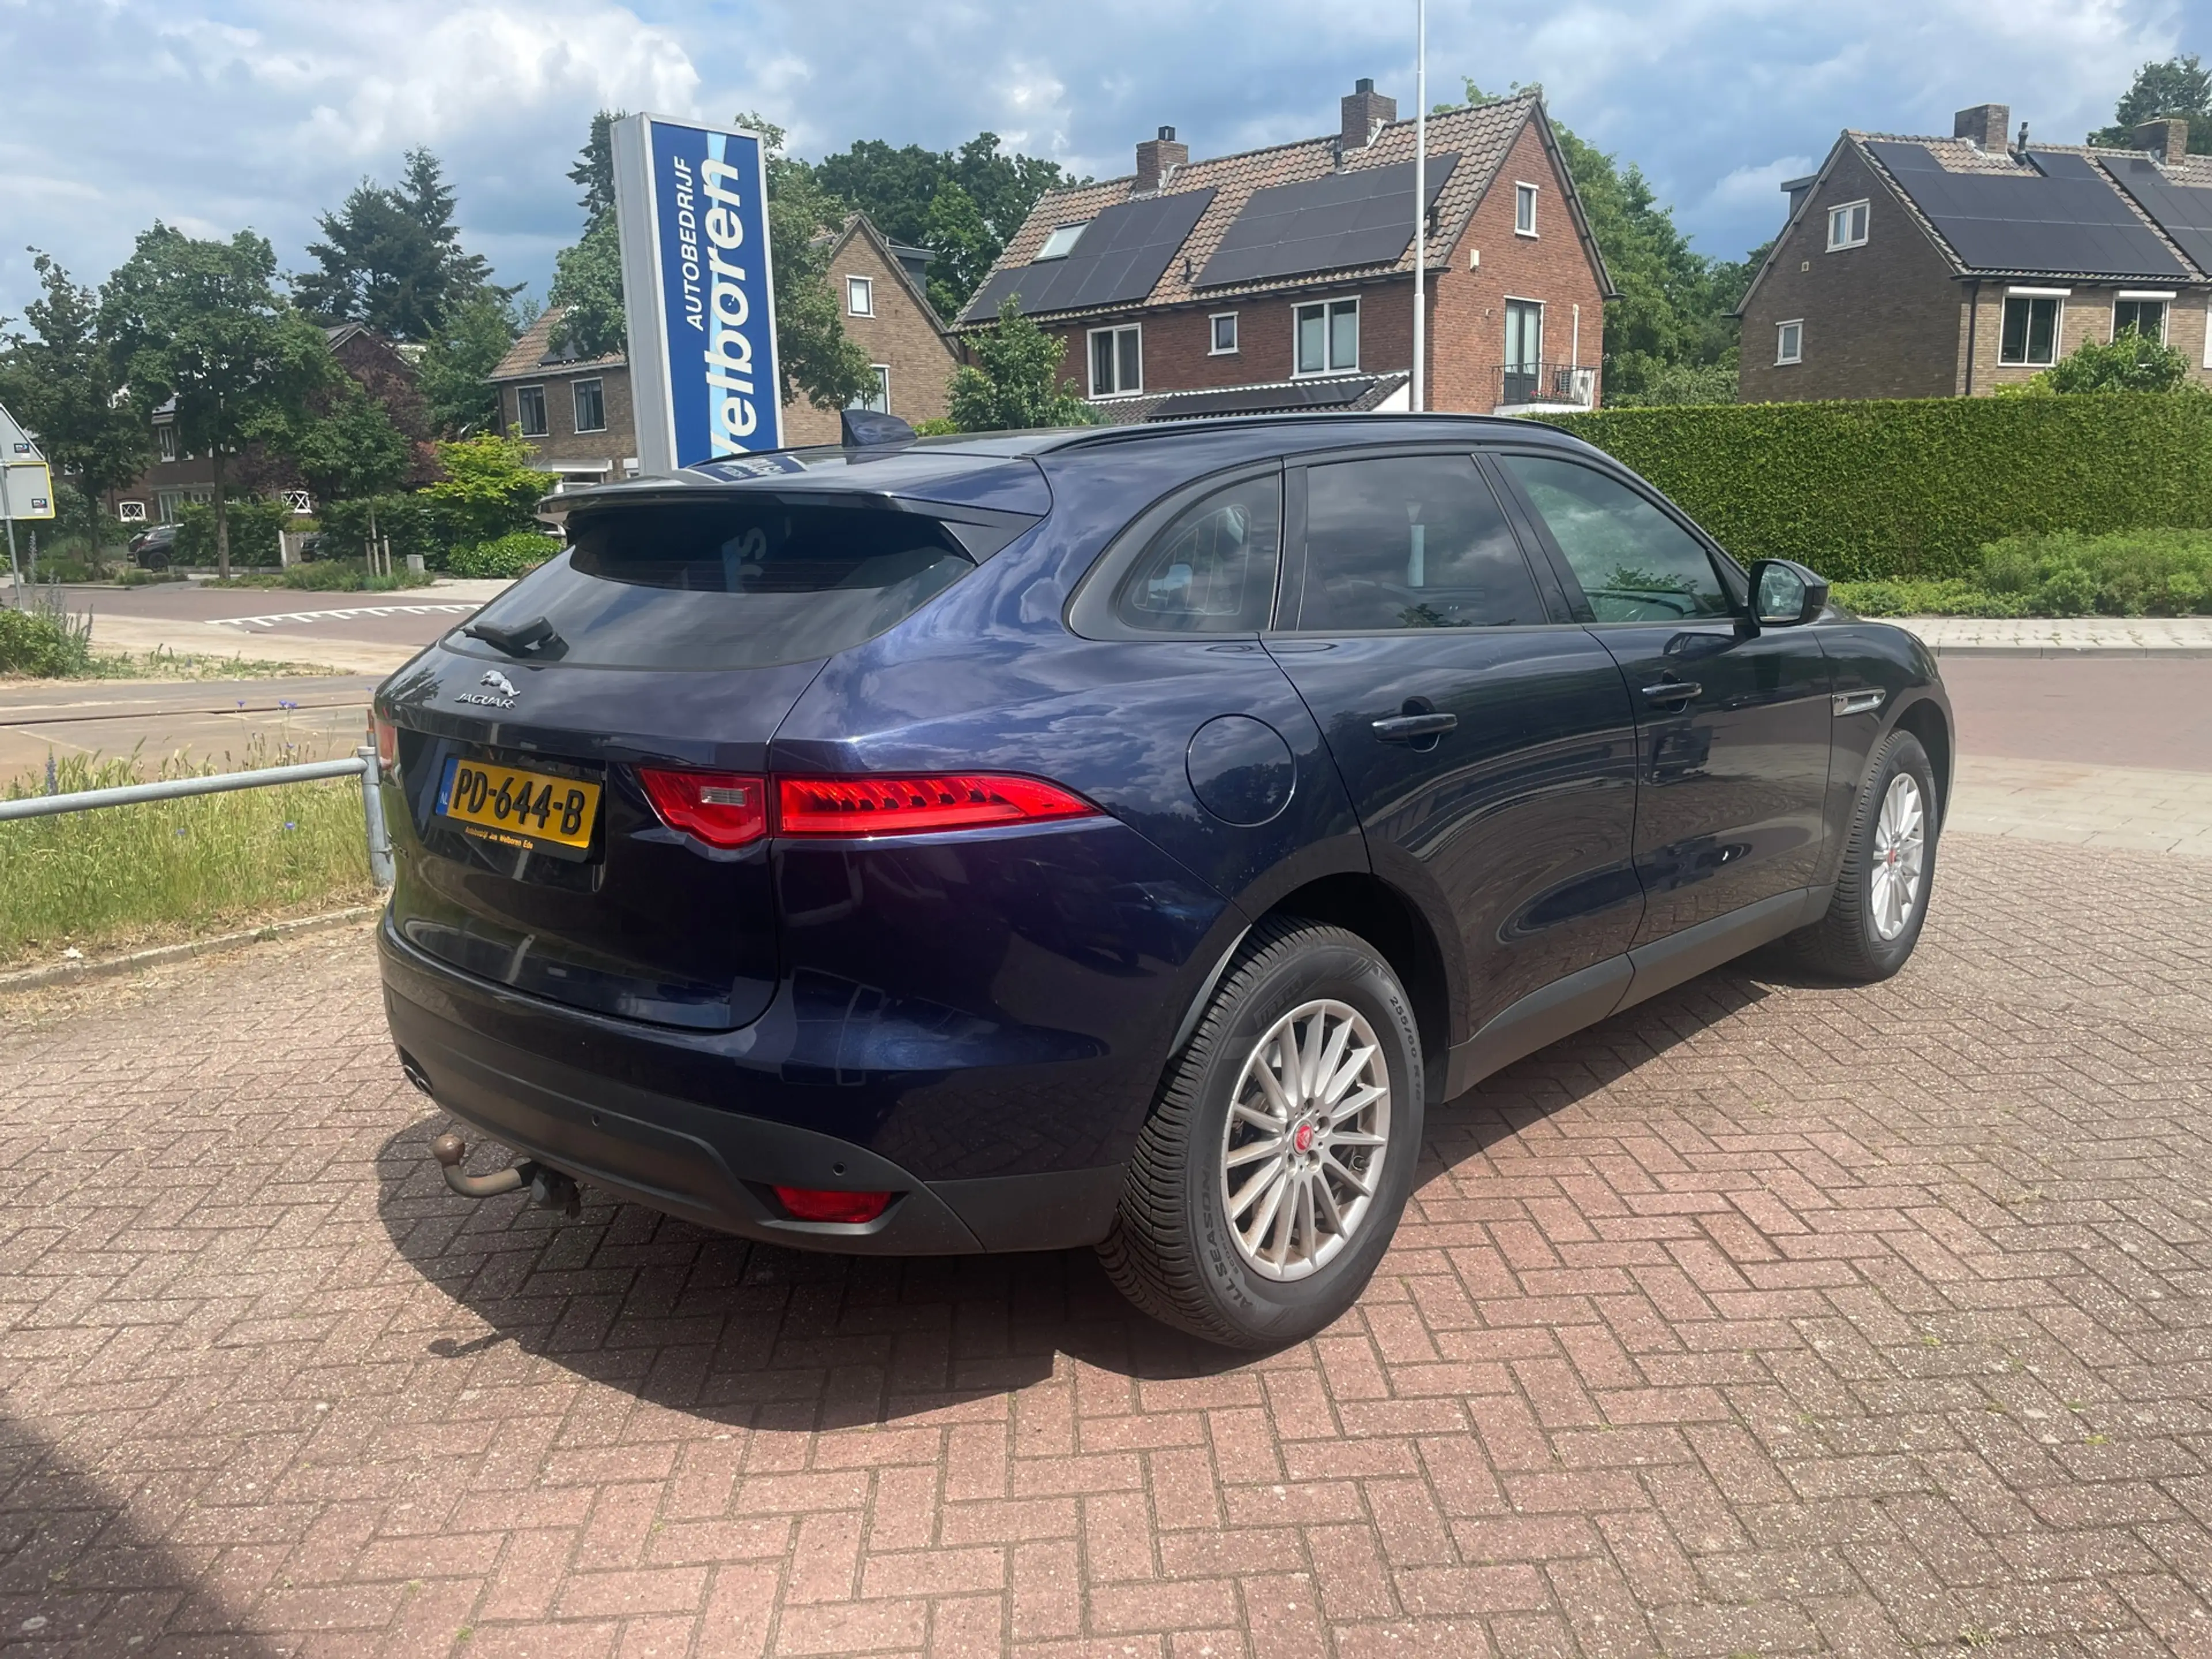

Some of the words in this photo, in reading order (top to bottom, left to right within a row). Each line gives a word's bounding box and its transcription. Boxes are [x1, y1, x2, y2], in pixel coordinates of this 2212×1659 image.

[673, 156, 704, 332] AUTOBEDRIJF
[454, 692, 517, 710] JAGUAR
[440, 791, 448, 805] NL
[453, 768, 585, 835] PD-644-B
